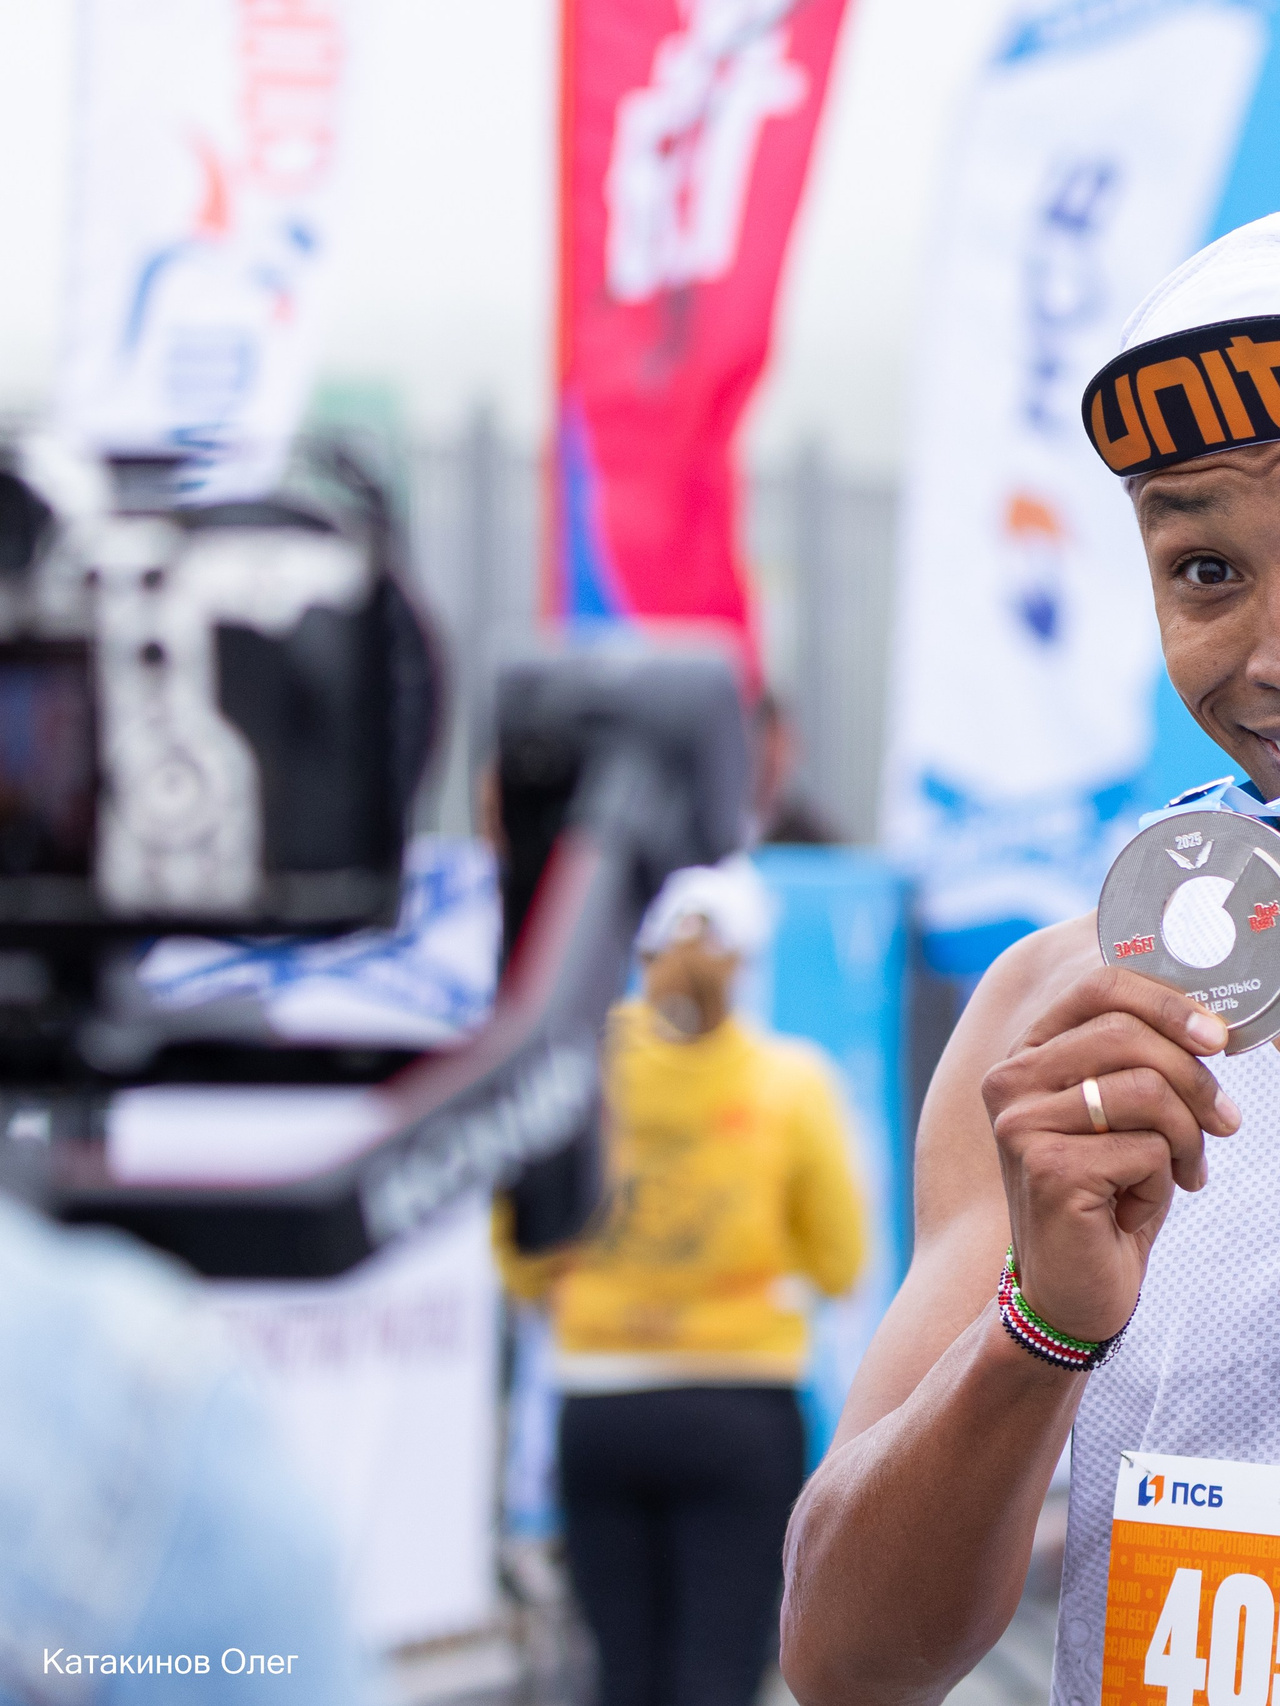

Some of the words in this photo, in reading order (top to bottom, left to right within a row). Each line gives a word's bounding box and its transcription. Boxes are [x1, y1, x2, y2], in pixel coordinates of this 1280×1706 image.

[1175, 832, 1203, 850] 2025
[1209, 978, 1262, 998] ТОЛЬКО
[1171, 1481, 1223, 1508] ПСБ
[1118, 1522, 1190, 1550] КИЛОМЕТРЫ
